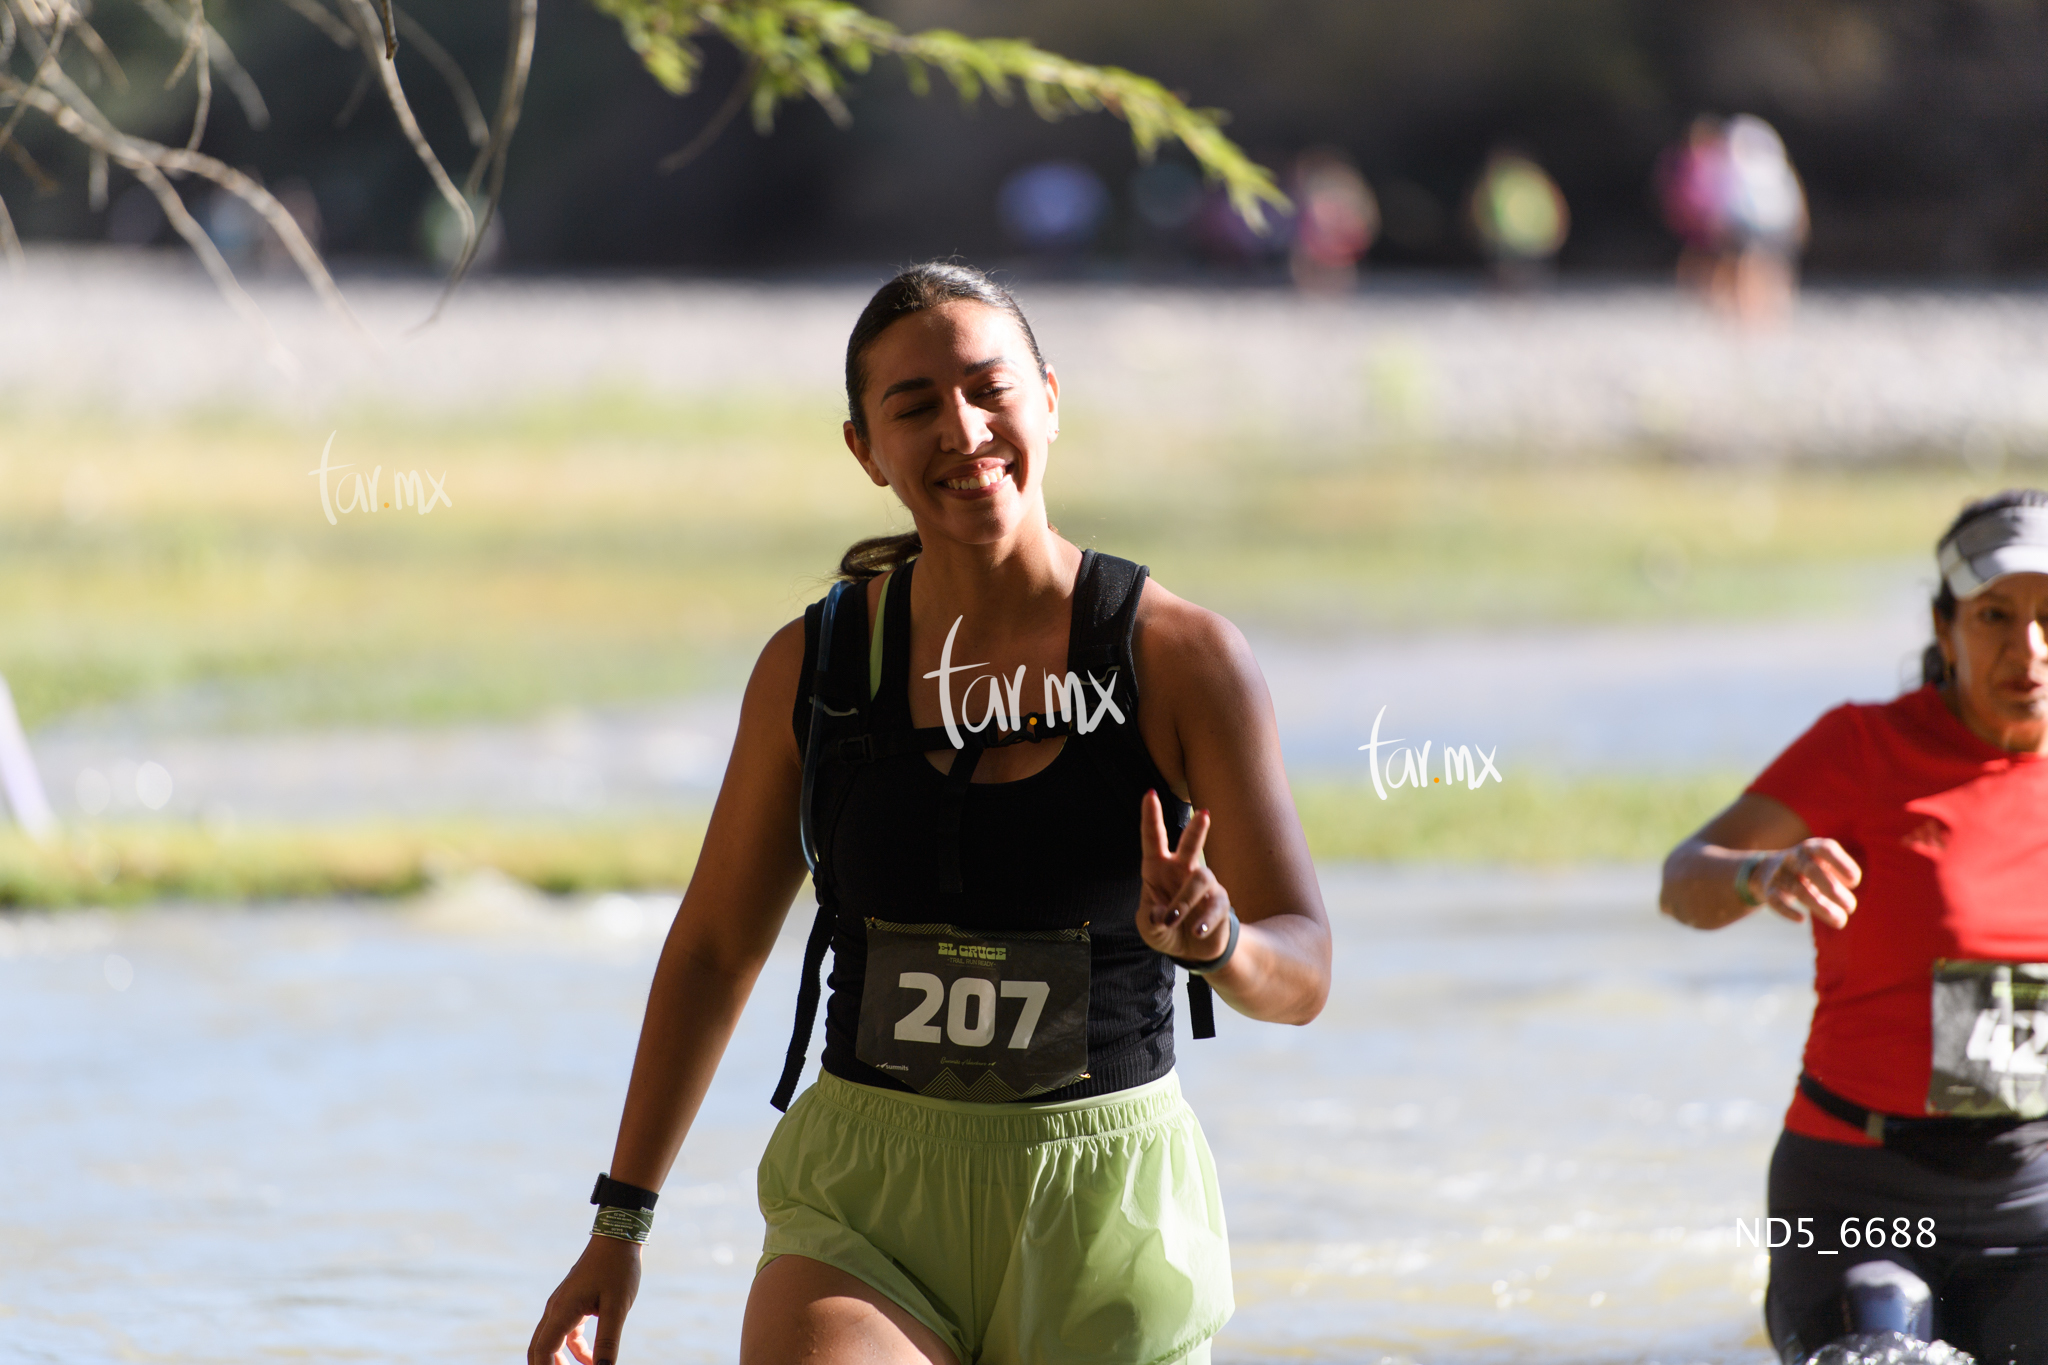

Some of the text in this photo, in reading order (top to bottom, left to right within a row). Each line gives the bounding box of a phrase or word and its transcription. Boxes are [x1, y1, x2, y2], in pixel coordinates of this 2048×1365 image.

[938, 943, 1007, 960] EL CRUCE
[894, 972, 1050, 1049] 207
